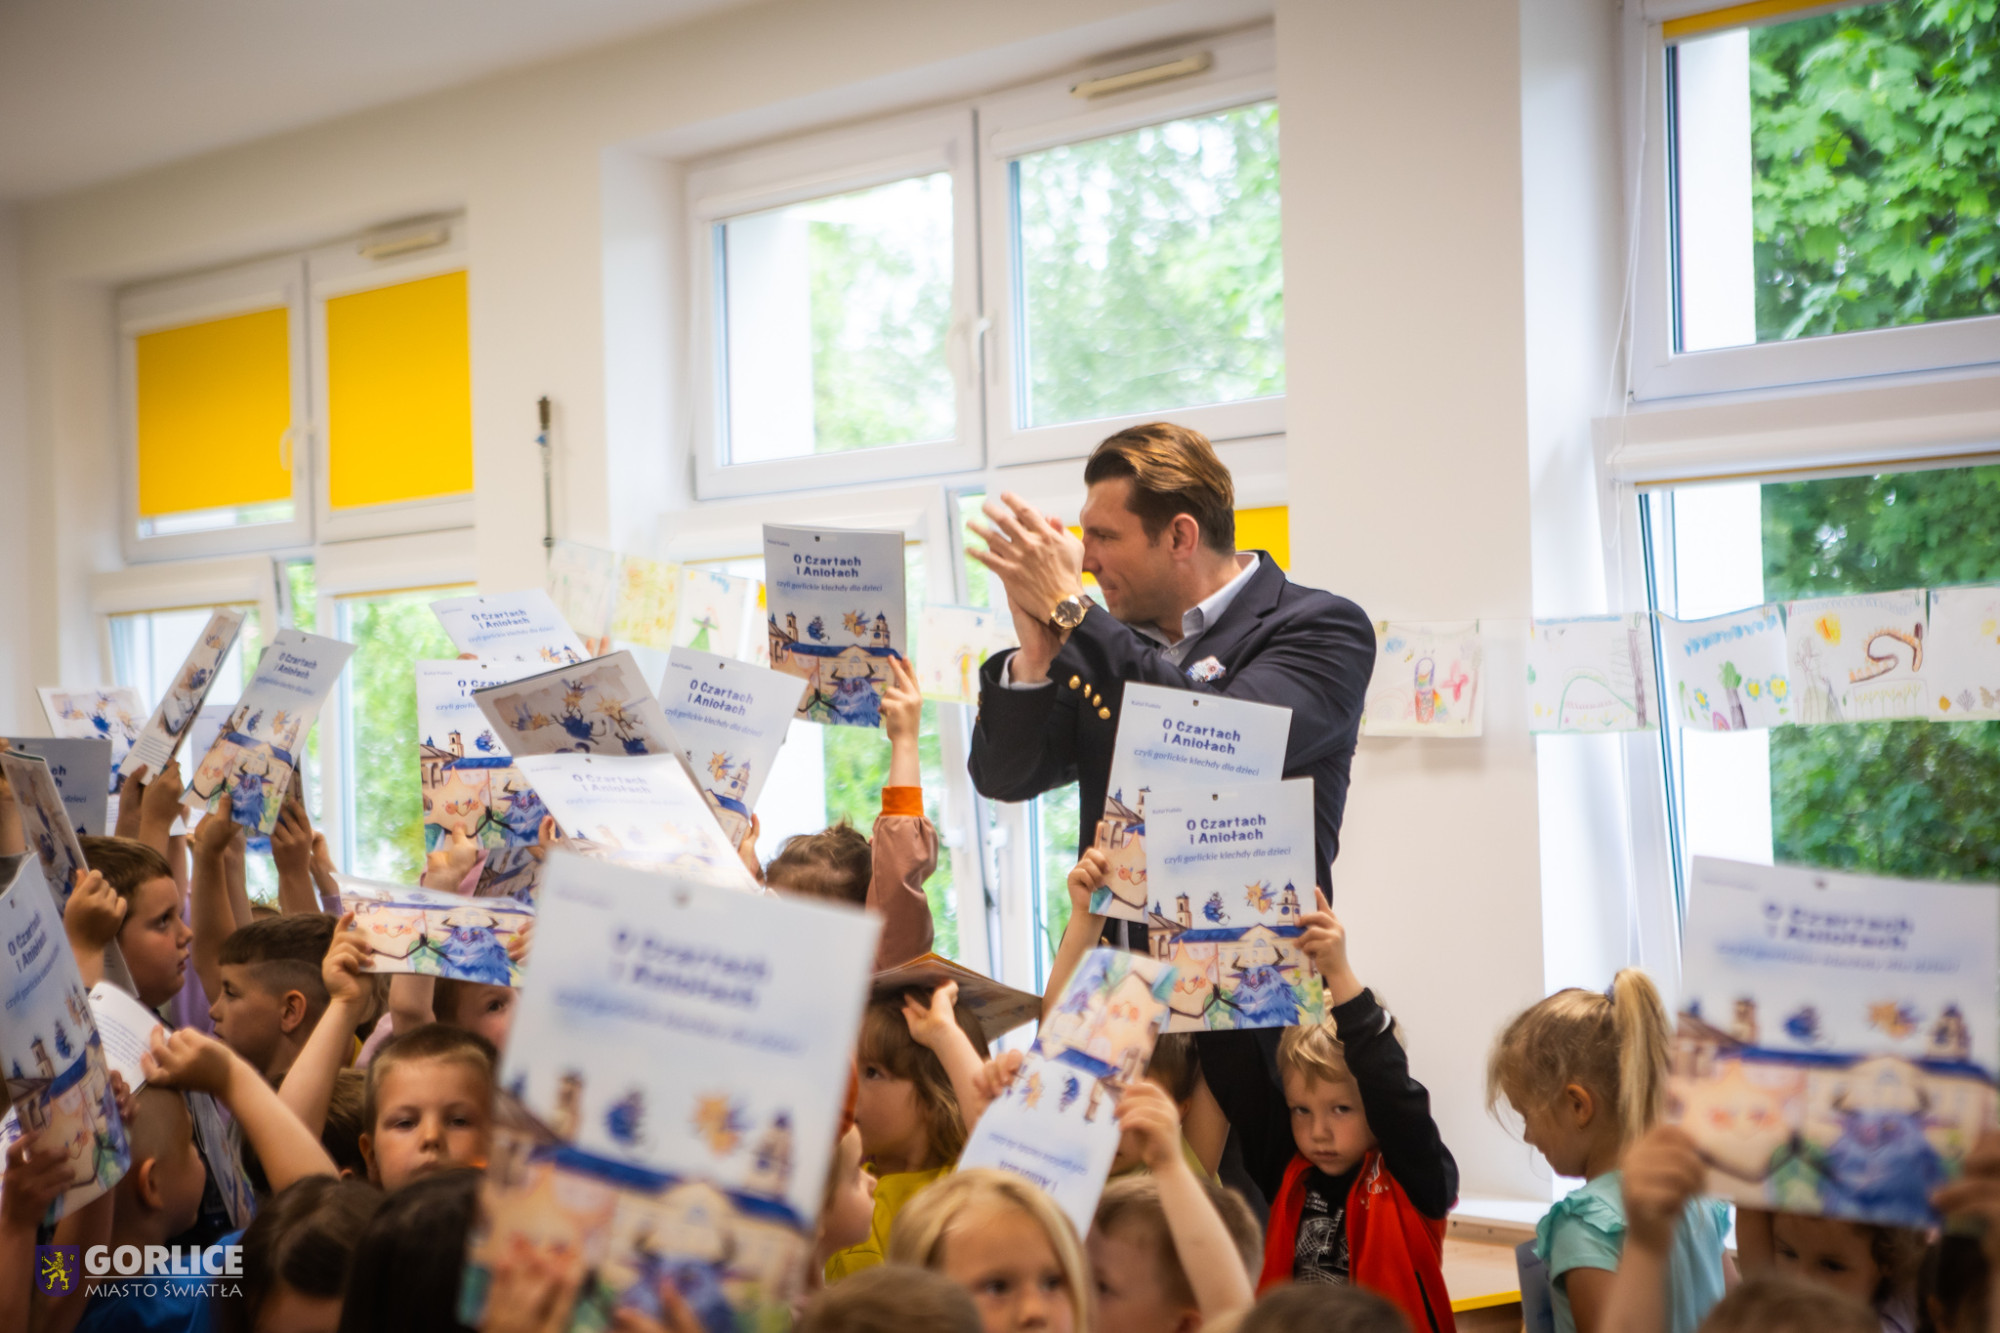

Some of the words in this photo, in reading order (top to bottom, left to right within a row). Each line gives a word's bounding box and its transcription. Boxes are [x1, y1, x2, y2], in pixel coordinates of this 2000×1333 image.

[794, 554, 802, 564] O
[805, 555, 861, 567] Czartach
[803, 567, 859, 577] Aniołach
[471, 613, 480, 622] O
[457, 680, 467, 688] O
[689, 679, 698, 690] O
[700, 681, 754, 704] Czartach
[693, 694, 746, 716] Aniołach
[1162, 718, 1172, 730] O
[1176, 720, 1241, 742] Czartach
[1171, 734, 1236, 755] Aniołach
[1133, 747, 1153, 758] czyli
[1221, 761, 1235, 773] dla
[1235, 763, 1260, 777] dzieci
[1186, 819, 1197, 831] O
[1200, 814, 1267, 830] Czartach
[1198, 828, 1264, 844] Aniołach
[1164, 855, 1183, 865] czyli
[1252, 848, 1266, 858] dla
[1267, 846, 1292, 857] dzieci
